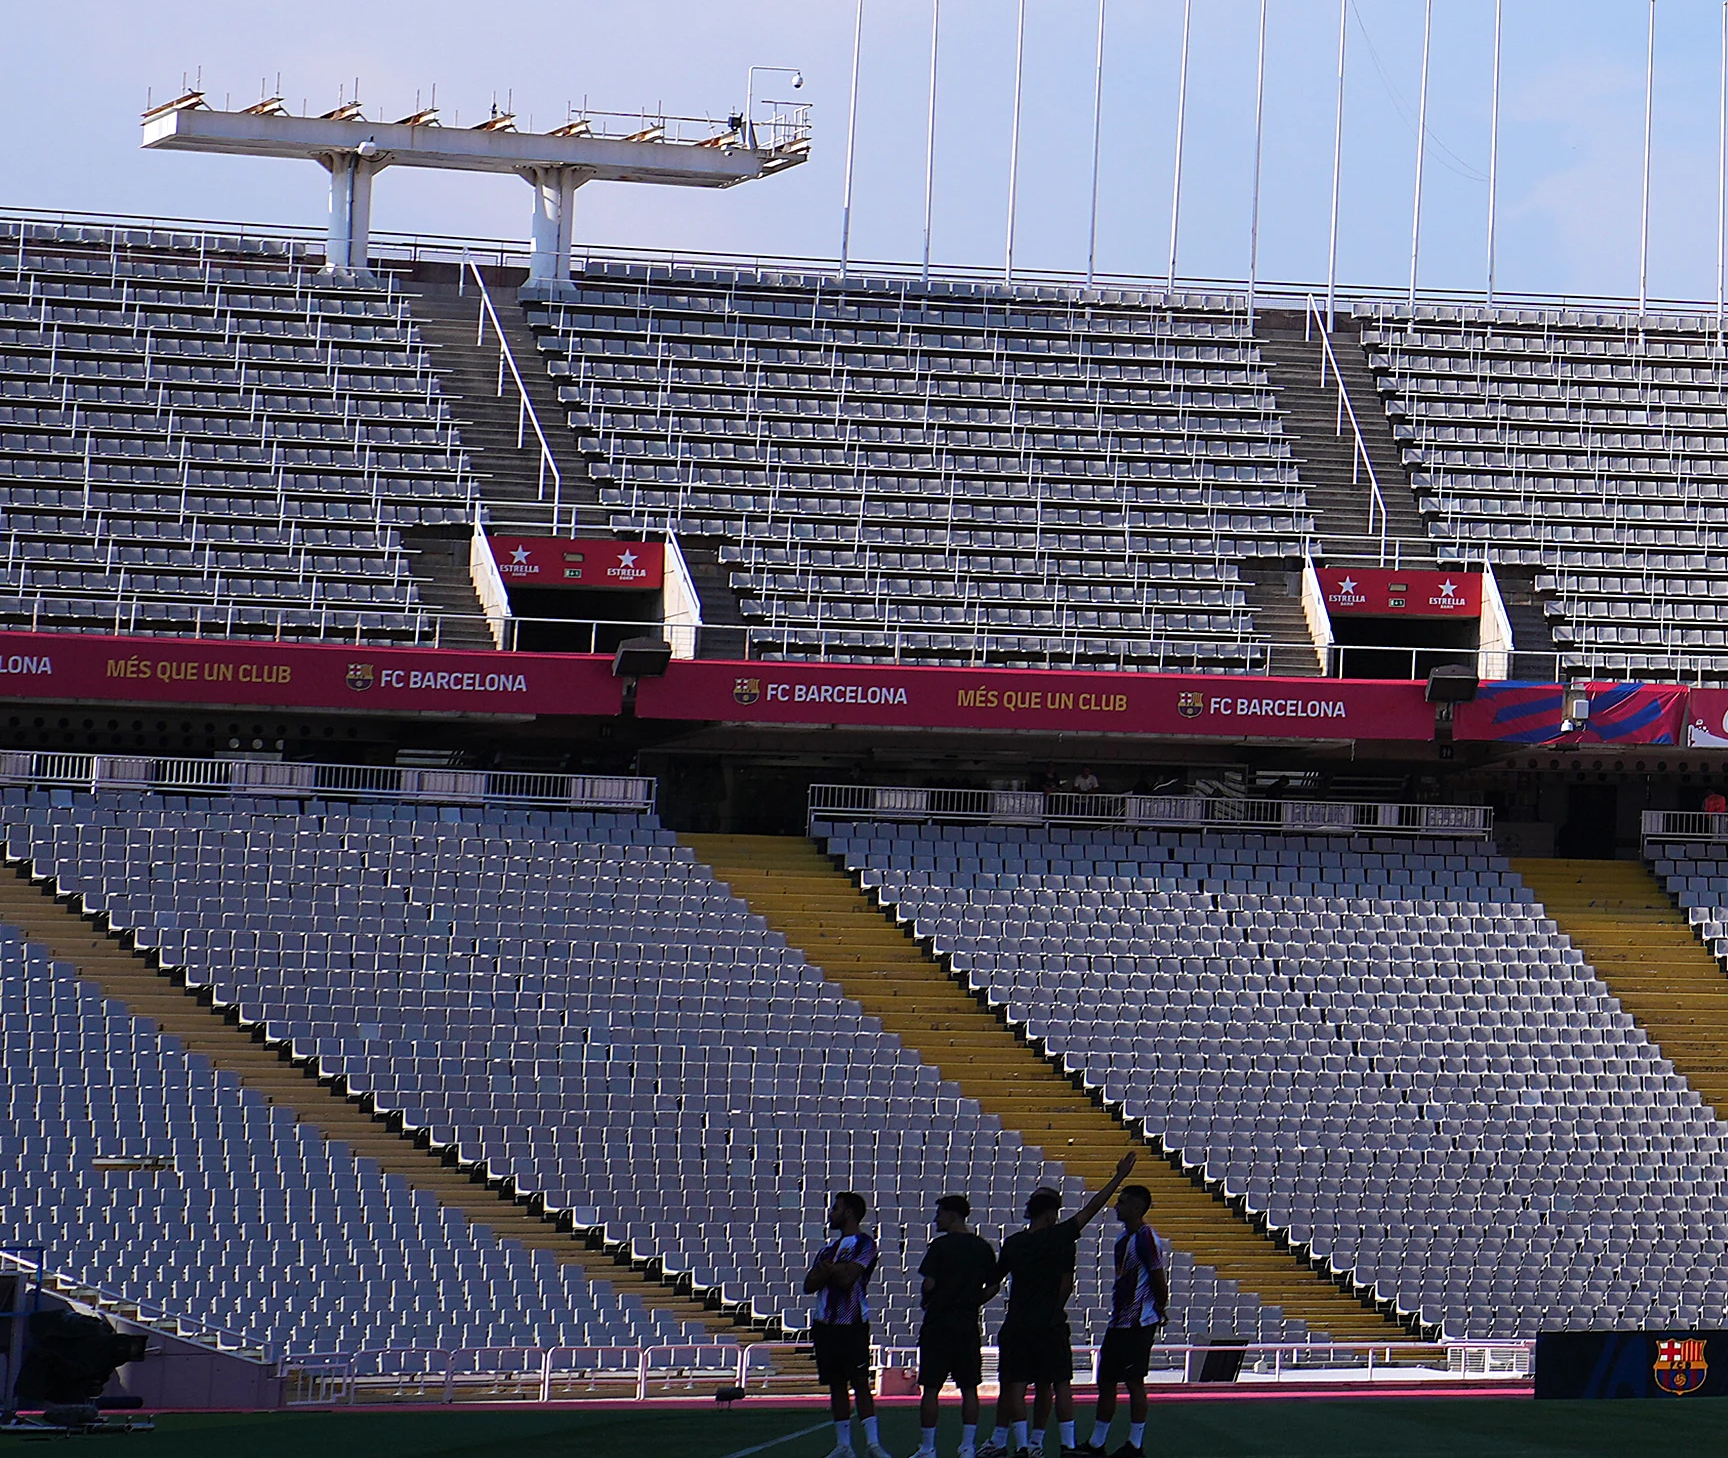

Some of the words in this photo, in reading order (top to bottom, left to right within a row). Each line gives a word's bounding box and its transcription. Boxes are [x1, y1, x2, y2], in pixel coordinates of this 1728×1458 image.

[500, 564, 540, 573] ESTRELLA
[607, 568, 647, 577] ESTRELLA
[1329, 594, 1366, 603] ESTRELLA
[1429, 597, 1466, 606] ESTRELLA
[106, 655, 151, 678] MÉS
[156, 662, 199, 683] QUE
[204, 663, 233, 682] UN
[238, 664, 292, 684] CLUB
[380, 669, 404, 688] FC
[409, 670, 528, 692] BARCELONA
[766, 683, 790, 701] FC
[794, 684, 908, 705] BARCELONA
[957, 686, 999, 707] MÉS
[1003, 690, 1041, 711] QUE
[1046, 691, 1074, 709] UN
[1078, 692, 1128, 712] CLUB
[1210, 697, 1233, 715] FC
[1236, 698, 1346, 718] BARCELONA
